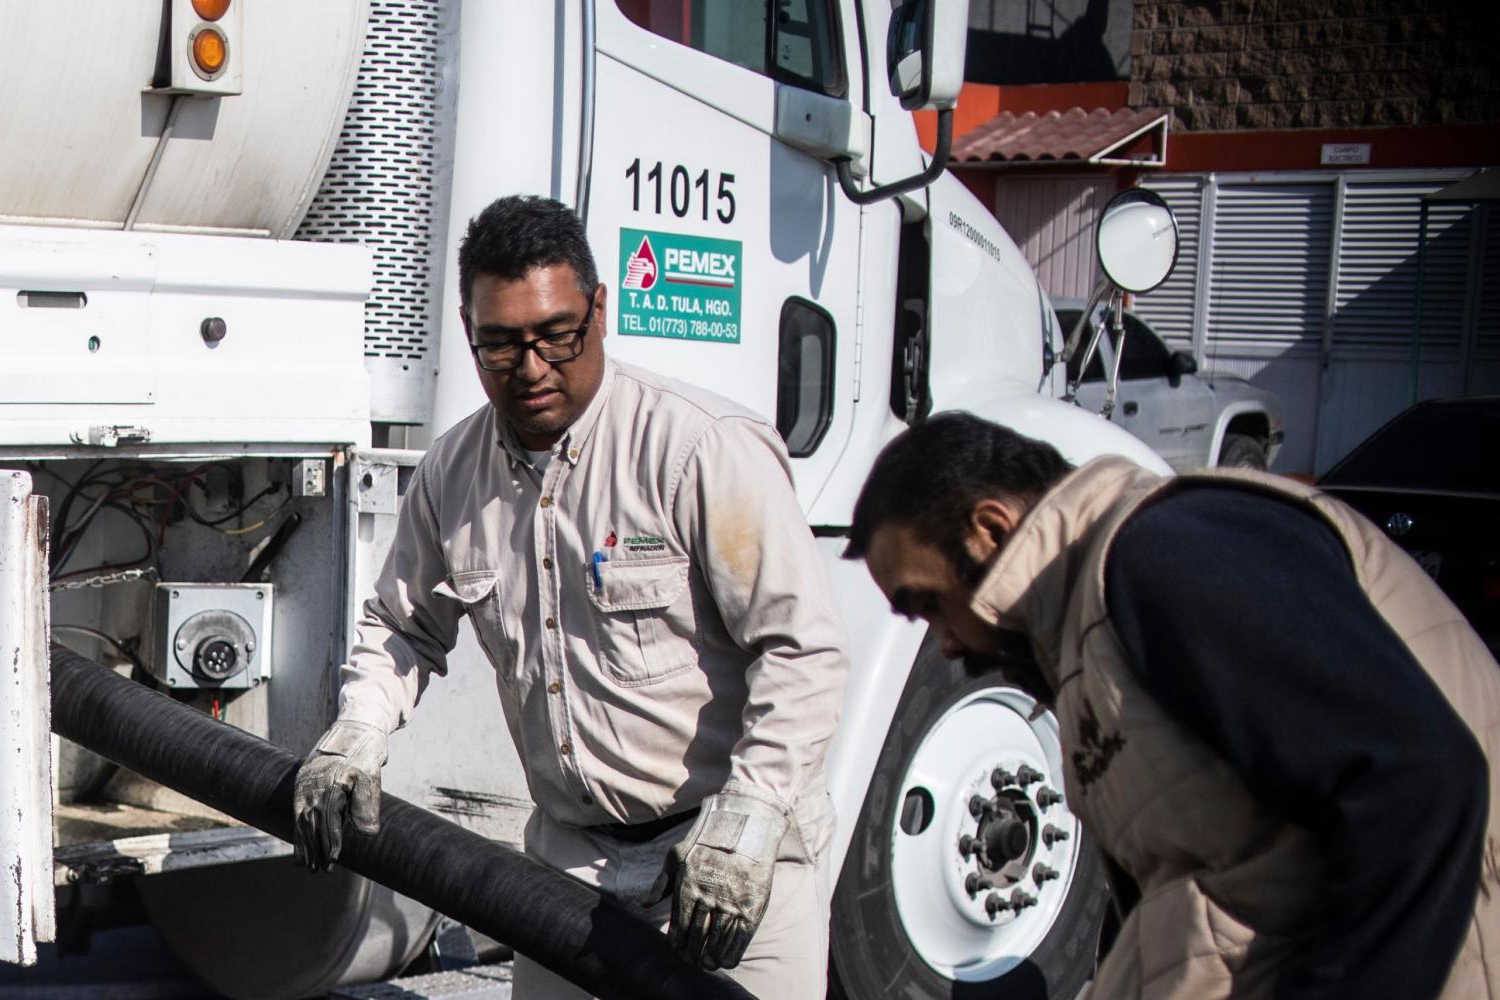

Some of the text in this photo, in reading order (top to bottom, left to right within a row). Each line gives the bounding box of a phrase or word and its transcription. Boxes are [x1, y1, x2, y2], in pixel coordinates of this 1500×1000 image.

[625, 157, 736, 224] 11015
[664, 247, 736, 277] PEMEX
[629, 292, 732, 316] T. A. D. TULA, HGO.
[622, 314, 738, 339] TEL. 01(773) 788-00-53
[623, 537, 665, 545] PEMEX
